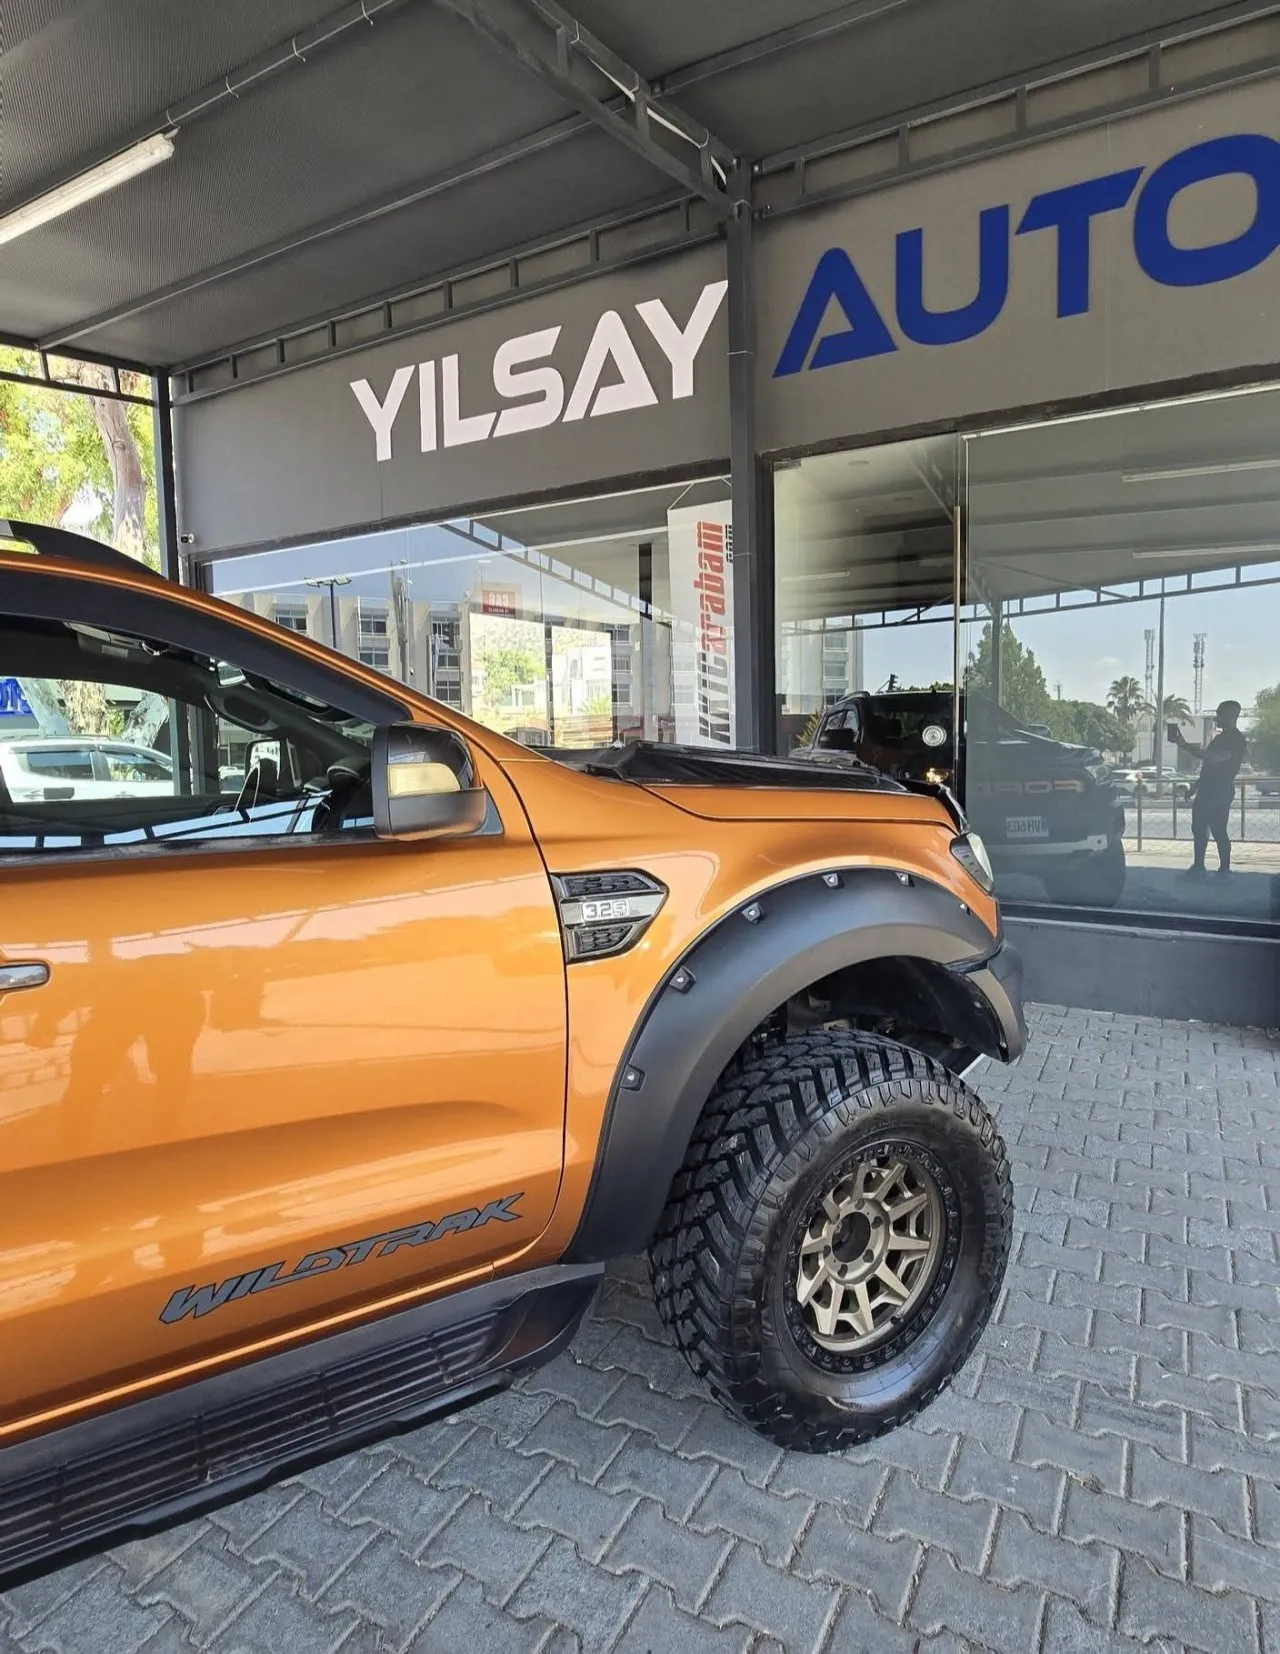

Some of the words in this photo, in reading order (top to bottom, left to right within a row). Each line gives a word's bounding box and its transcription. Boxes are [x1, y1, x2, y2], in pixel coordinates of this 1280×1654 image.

[772, 133, 1280, 378] AUTO
[349, 280, 729, 462] YILSAY
[158, 1192, 525, 1324] WILDTRAK
